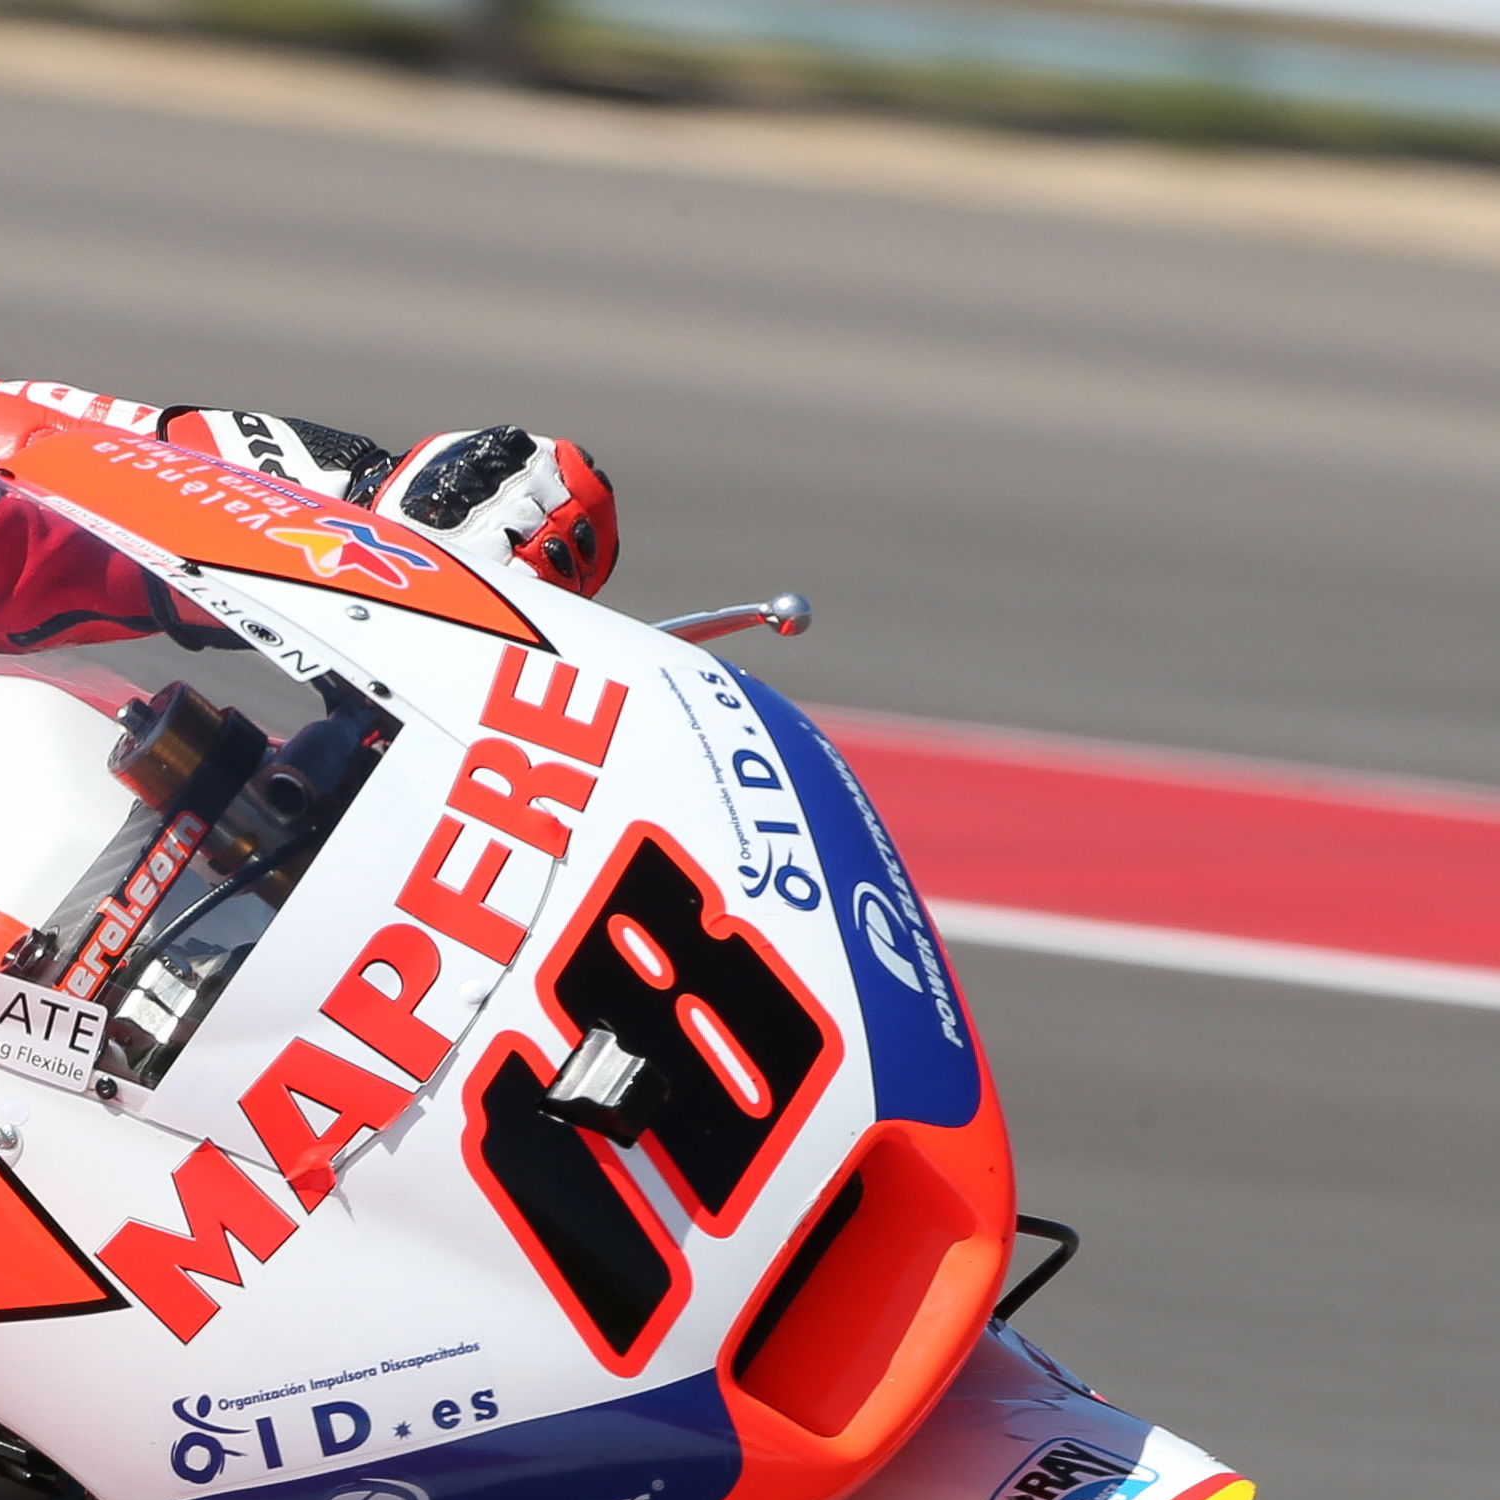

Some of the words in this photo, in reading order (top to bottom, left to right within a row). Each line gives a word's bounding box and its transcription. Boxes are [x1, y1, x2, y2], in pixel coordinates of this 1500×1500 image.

[94, 643, 629, 1344] MAPFRE
[15, 1045, 84, 1081] Flexible
[218, 1382, 305, 1412] Organización
[310, 1364, 377, 1391] Impulsora
[381, 1341, 480, 1374] Discapacitados
